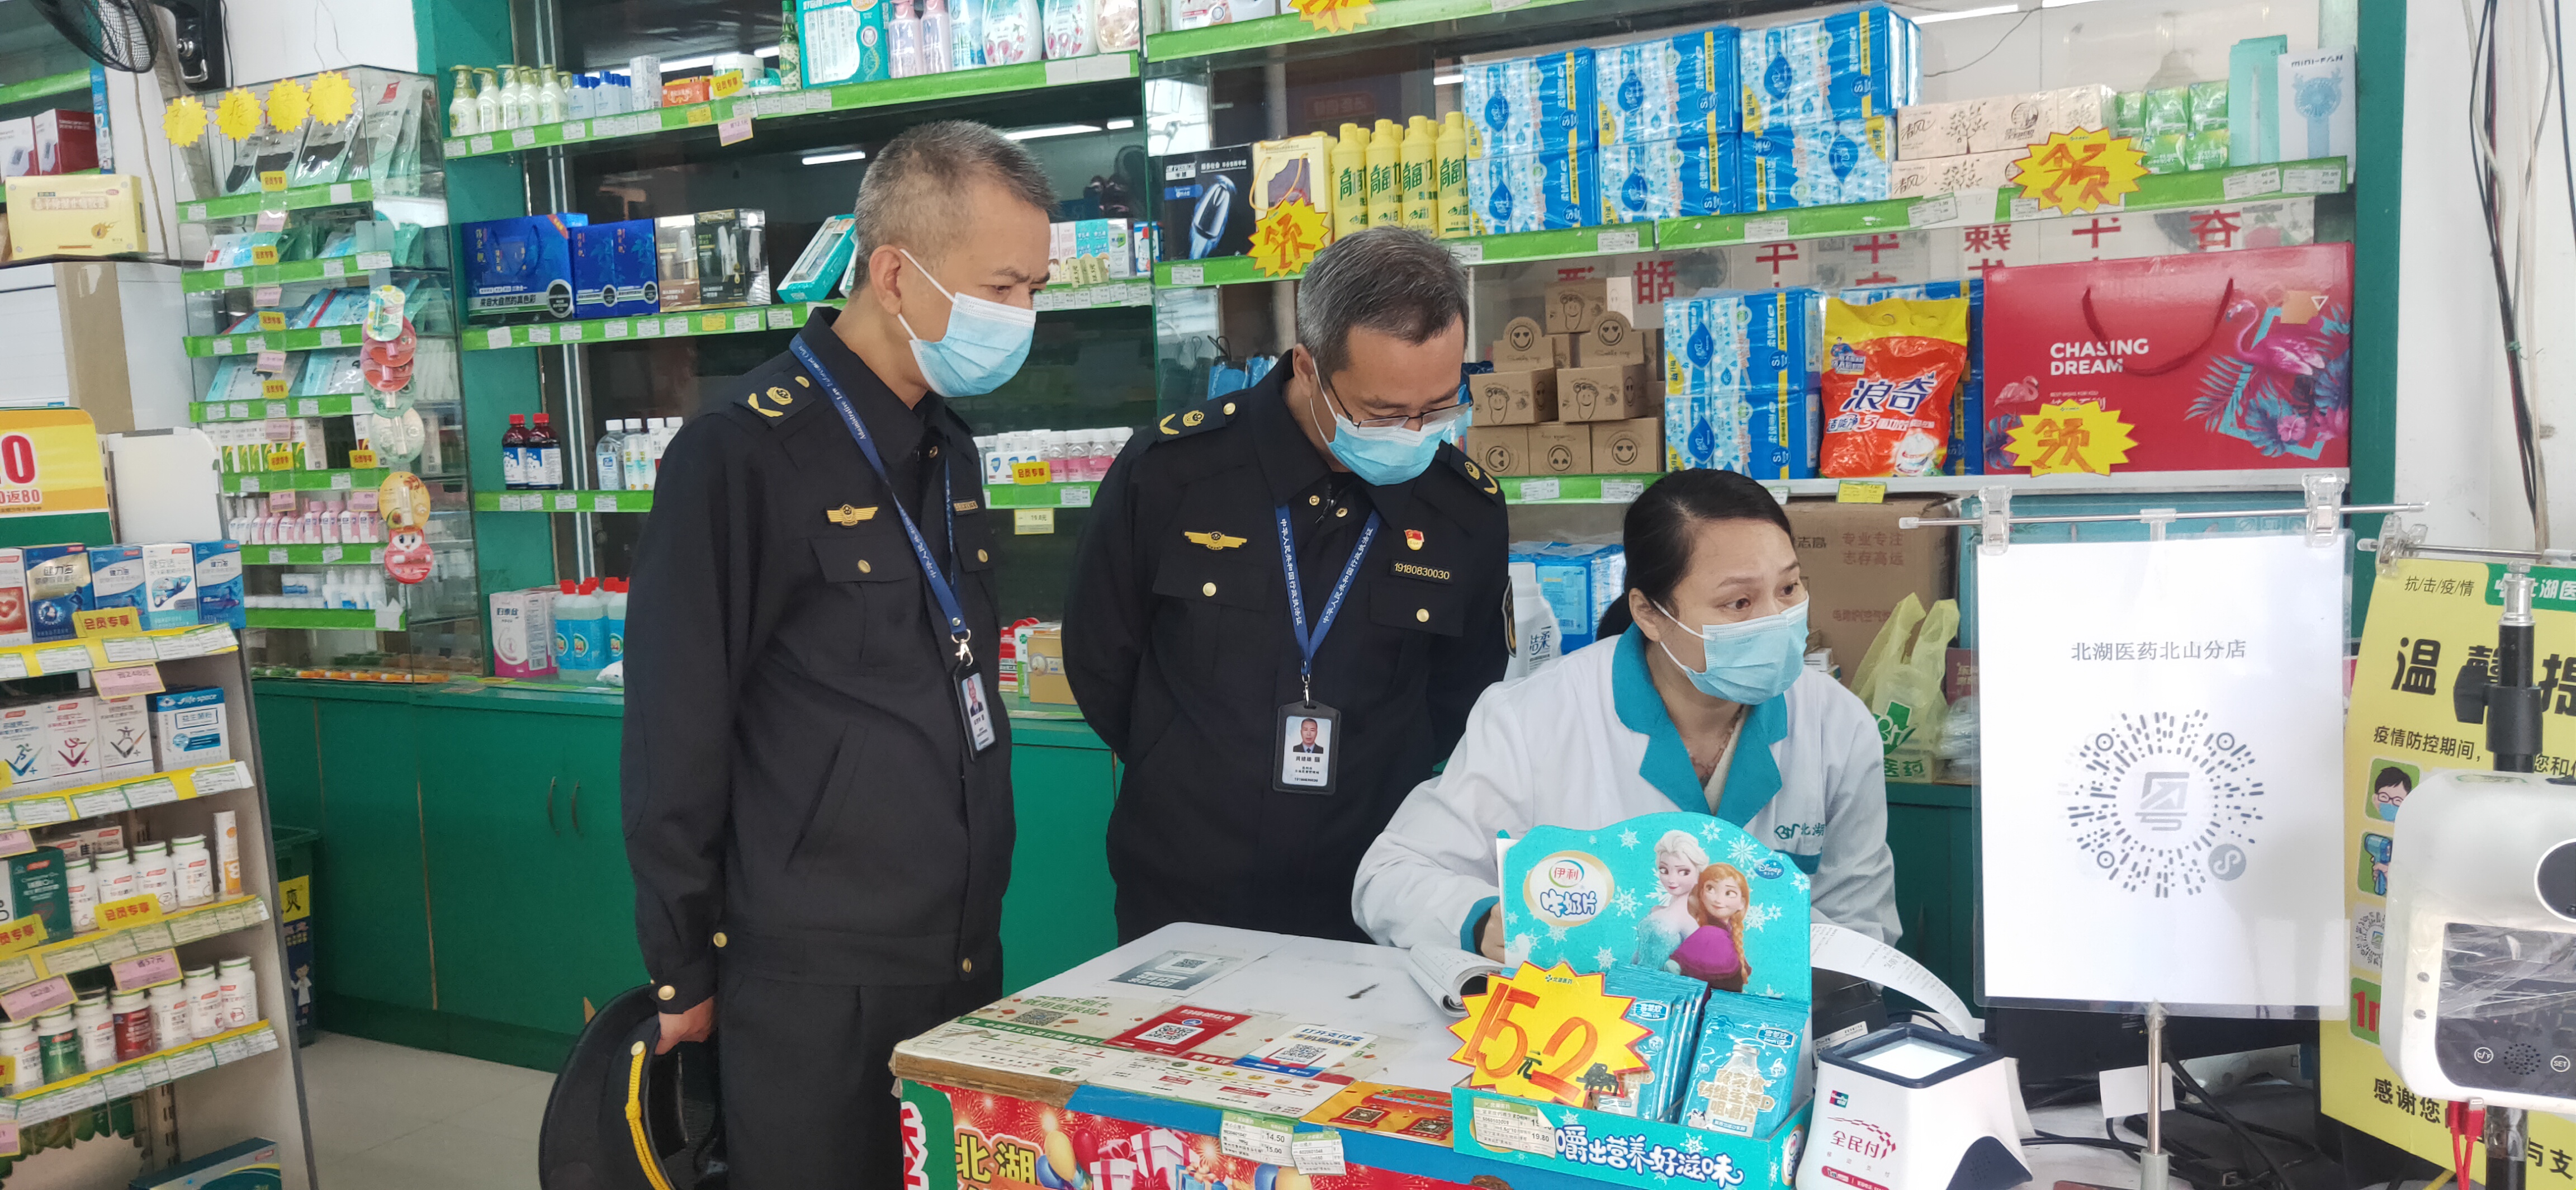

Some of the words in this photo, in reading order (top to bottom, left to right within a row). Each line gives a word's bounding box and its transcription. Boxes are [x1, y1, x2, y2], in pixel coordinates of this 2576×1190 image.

[2049, 338, 2150, 359] CHASING
[2049, 358, 2124, 376] DREAM
[1840, 375, 1938, 417] 浪奇
[0, 435, 35, 484] 0
[1842, 532, 1904, 547] 专业专注
[1279, 517, 1303, 627] 中华人民共和国行政执法证
[1322, 526, 1375, 625] 中华人民共和国行政执法证
[1394, 562, 1451, 581] 19180830030
[2404, 576, 2475, 597] 抗/击/疫/情
[84, 615, 130, 630] 会员专享
[2071, 639, 2247, 662] 北湖医药北山分店
[1553, 866, 1580, 882] 伊利
[104, 901, 150, 922] 会员专享
[1539, 887, 1599, 919] 牛奶片
[1300, 1028, 1365, 1042] 打开支付宝
[2373, 1078, 2441, 1125] 感谢您
[1266, 1132, 1285, 1143] 14.50
[1531, 1133, 1550, 1142] 19.80
[1830, 1130, 1880, 1159] 全民付
[954, 1132, 1037, 1186] 北湖
[1266, 1146, 1282, 1154] 15.00
[1555, 1125, 1746, 1189] 嚼出营养好滋味
